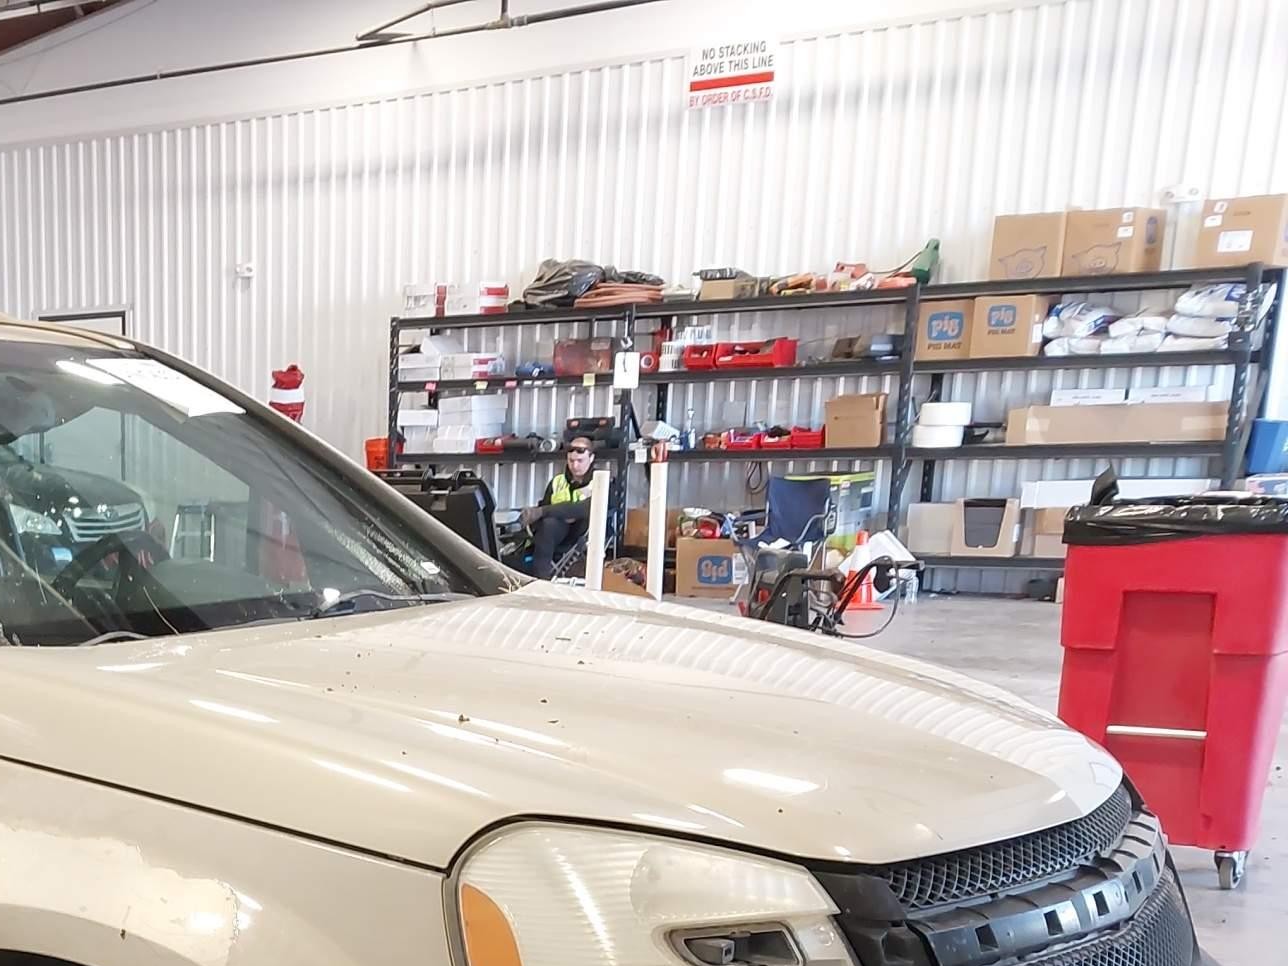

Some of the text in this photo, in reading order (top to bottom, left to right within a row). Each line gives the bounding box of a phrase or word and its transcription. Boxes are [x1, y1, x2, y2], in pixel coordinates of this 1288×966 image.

[702, 40, 766, 60] NO STACKING
[693, 54, 774, 77] ABOVE THIS LINE
[689, 95, 699, 107] BY
[702, 92, 729, 106] ORDER
[731, 89, 742, 102] OF
[931, 315, 960, 338] pig
